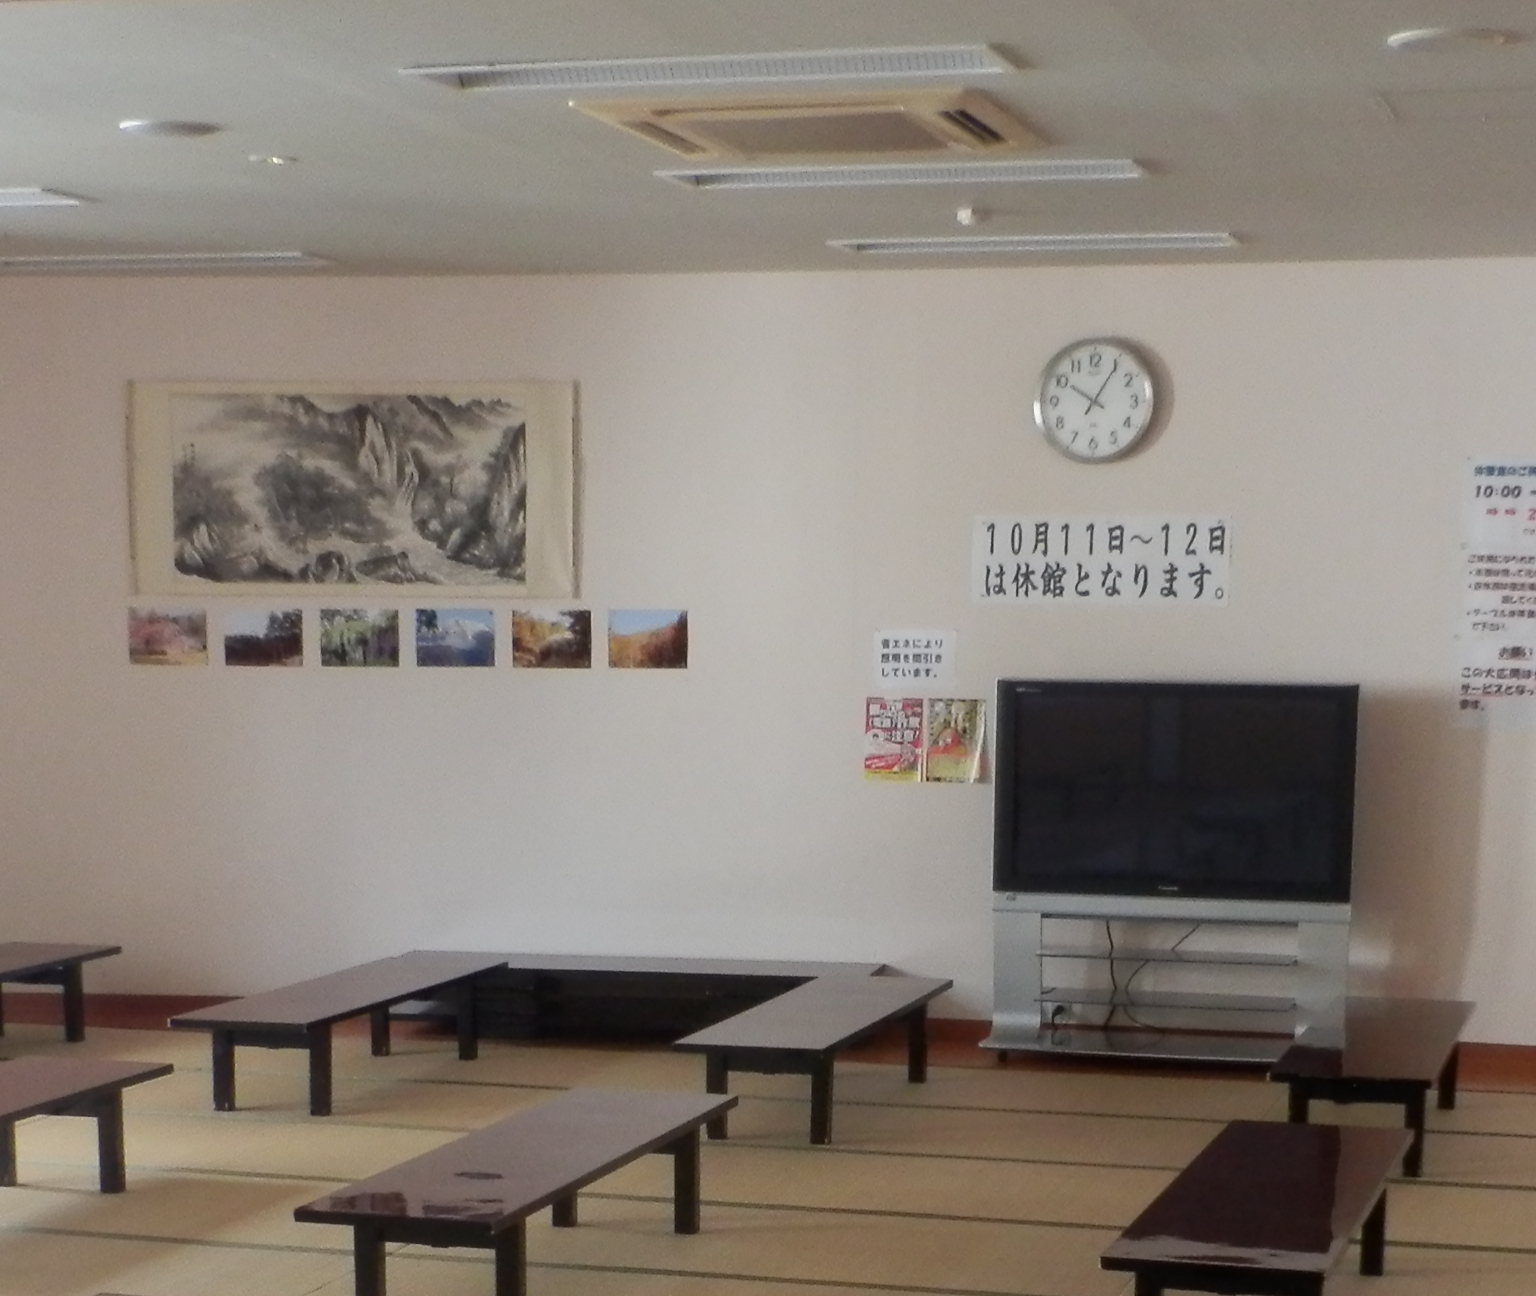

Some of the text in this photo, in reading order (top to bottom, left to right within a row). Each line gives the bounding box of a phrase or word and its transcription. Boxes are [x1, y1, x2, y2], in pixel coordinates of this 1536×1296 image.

[1070, 359, 1081, 373] 11
[1089, 353, 1102, 368] 12
[1056, 374, 1069, 389] 10
[1123, 372, 1134, 388] 2
[1049, 395, 1060, 409] 9
[1130, 393, 1139, 410] 3
[1055, 416, 1064, 430] 8
[1123, 416, 1131, 429] 4
[1071, 431, 1079, 444] 7
[1088, 436, 1098, 450] 6
[1110, 430, 1118, 445] 5
[1475, 485, 1522, 499] 10:00
[986, 522, 1226, 558] 10月11日～12日
[984, 561, 1224, 600] は休館となります。
[881, 638, 944, 650] 省エネにより
[880, 653, 943, 664] 照明を間引き
[881, 667, 938, 679] しています。
